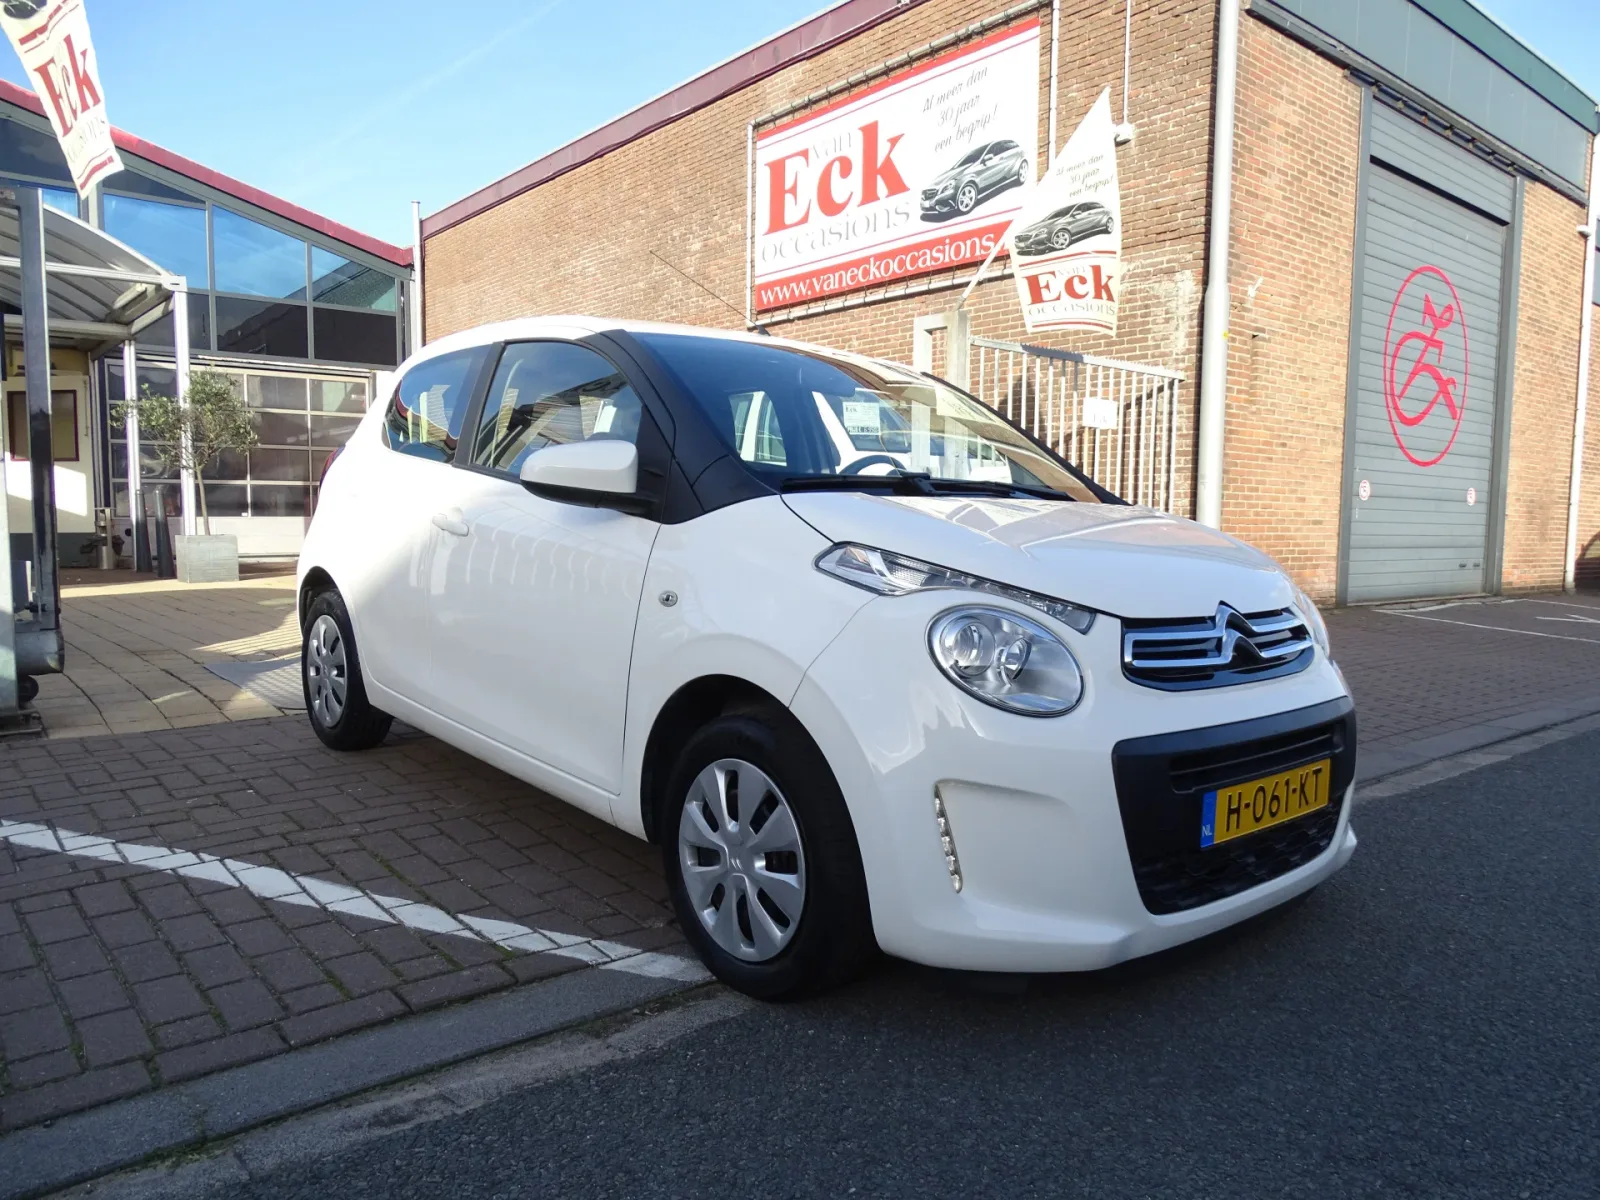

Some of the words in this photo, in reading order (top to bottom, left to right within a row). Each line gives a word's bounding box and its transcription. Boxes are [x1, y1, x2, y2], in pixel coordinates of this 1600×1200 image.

[33, 34, 101, 138] Eck
[923, 94, 935, 113] Al
[937, 82, 963, 105] meer
[965, 66, 988, 88] dan
[938, 106, 954, 127] 30
[953, 94, 980, 127] jaar
[812, 131, 852, 159] van
[934, 135, 952, 153] een
[762, 120, 911, 236] Eck
[762, 202, 911, 263] occasions
[761, 233, 1009, 305] www.vaneckoccasions
[1021, 264, 1116, 306] Eck
[1028, 300, 1115, 316] occasions
[1226, 765, 1324, 833] H-061-KT
[1202, 824, 1213, 838] NL
